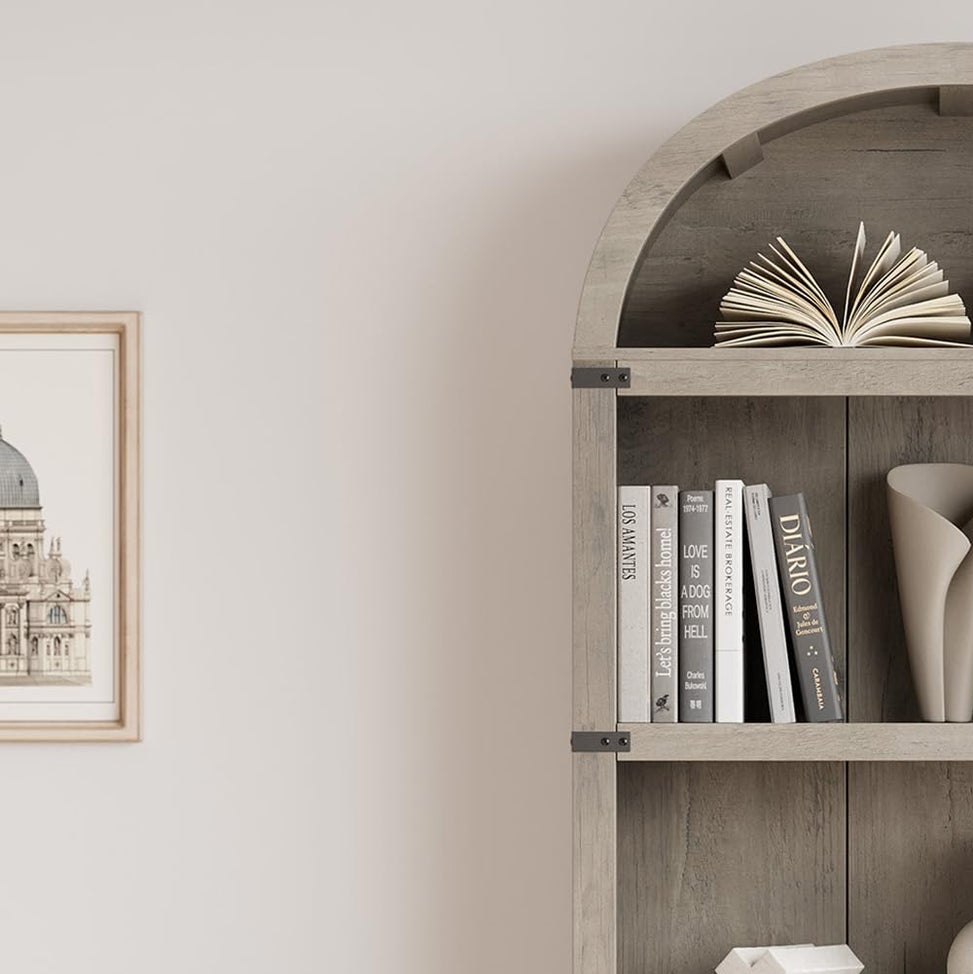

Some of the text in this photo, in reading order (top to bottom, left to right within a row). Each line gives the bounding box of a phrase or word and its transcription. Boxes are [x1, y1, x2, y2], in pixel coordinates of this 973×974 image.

[622, 505, 636, 580] LOS AMANTES
[683, 544, 708, 558] LOVE
[780, 514, 812, 596] DIÁRIO
[691, 564, 700, 578] IS
[681, 585, 711, 598] A DOG
[725, 553, 733, 616] BROKERAGE
[655, 528, 676, 678] Let's bring blacks home!
[793, 603, 818, 613] Edmond
[682, 604, 709, 619] FROM
[684, 625, 708, 639] HELL
[812, 668, 824, 711] CARAMBAIA
